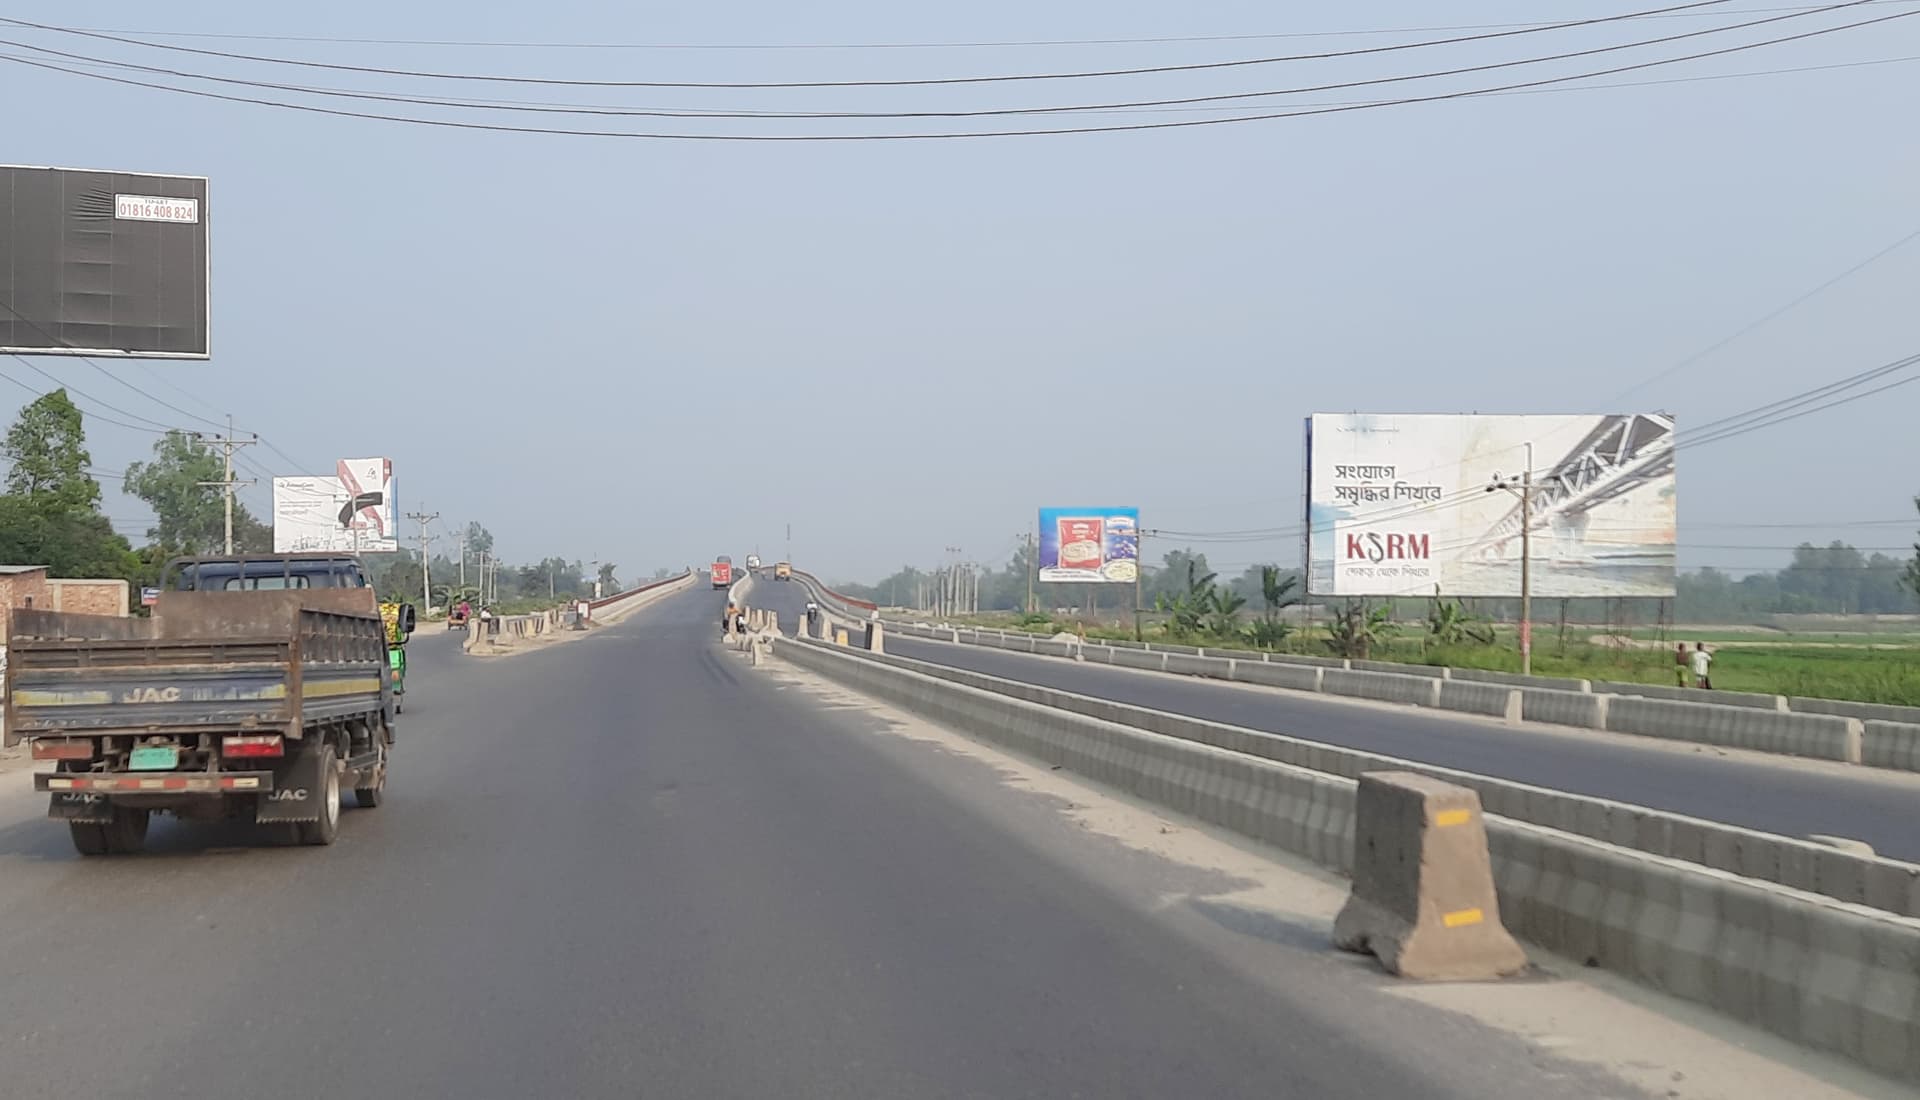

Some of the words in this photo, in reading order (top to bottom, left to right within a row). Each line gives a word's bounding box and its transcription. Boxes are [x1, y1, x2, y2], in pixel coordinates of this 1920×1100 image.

[120, 203, 151, 217] 01816
[153, 206, 172, 218] 408
[174, 207, 192, 219] 824
[1335, 465, 1396, 479] সংযোগে
[1335, 481, 1390, 505] সমৃদ্ধির
[1394, 481, 1442, 501] শিখরে
[1347, 532, 1429, 564] KSRM
[122, 687, 182, 704] JAC
[268, 789, 308, 801] JAC
